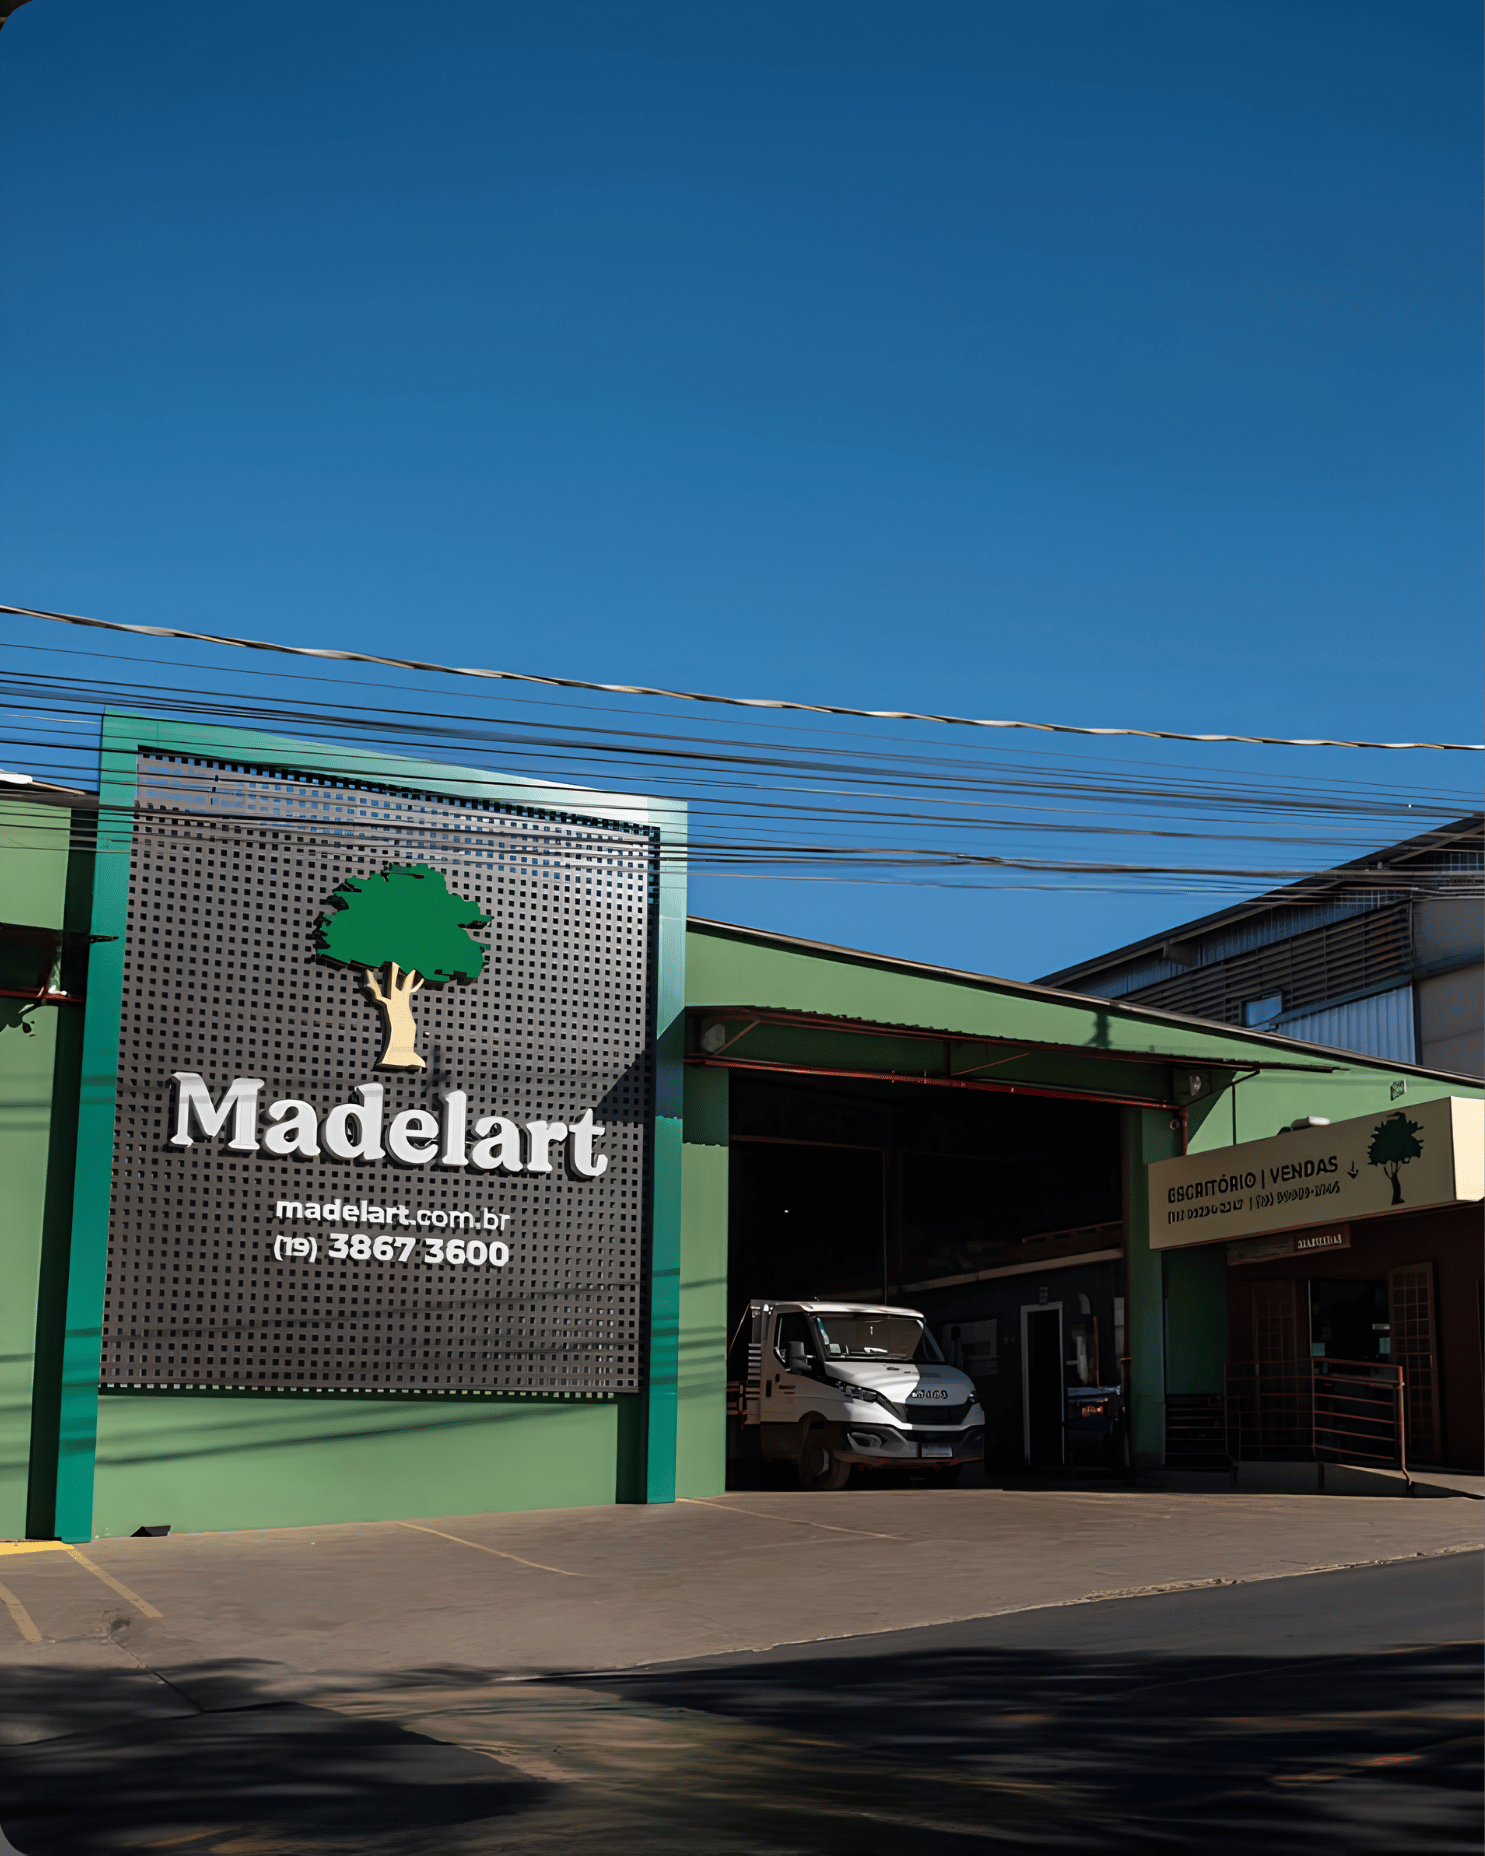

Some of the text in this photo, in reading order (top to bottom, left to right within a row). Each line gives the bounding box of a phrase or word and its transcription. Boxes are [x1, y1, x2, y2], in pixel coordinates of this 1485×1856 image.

[169, 1071, 608, 1178] Madelart
[1270, 1156, 1338, 1184] VENDAS
[276, 1198, 510, 1231] madelart.com.br
[273, 1232, 510, 1267] (19) 3867 3600
